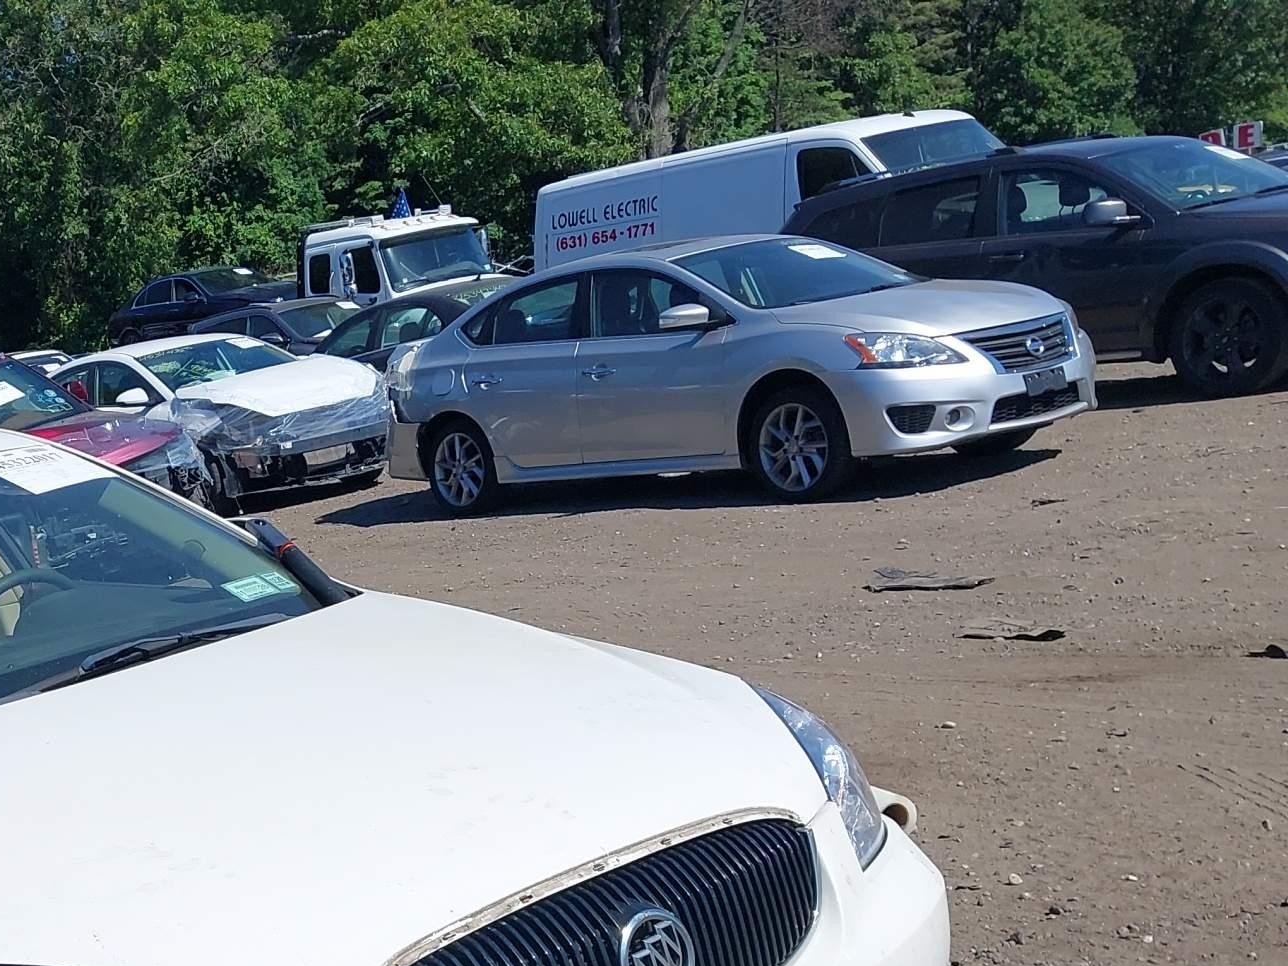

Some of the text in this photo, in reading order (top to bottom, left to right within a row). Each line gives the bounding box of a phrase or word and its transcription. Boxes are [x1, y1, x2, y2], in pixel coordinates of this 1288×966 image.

[1238, 124, 1255, 148] E
[551, 195, 658, 230] LOWELL ELECTRIC
[556, 233, 588, 252] (631)
